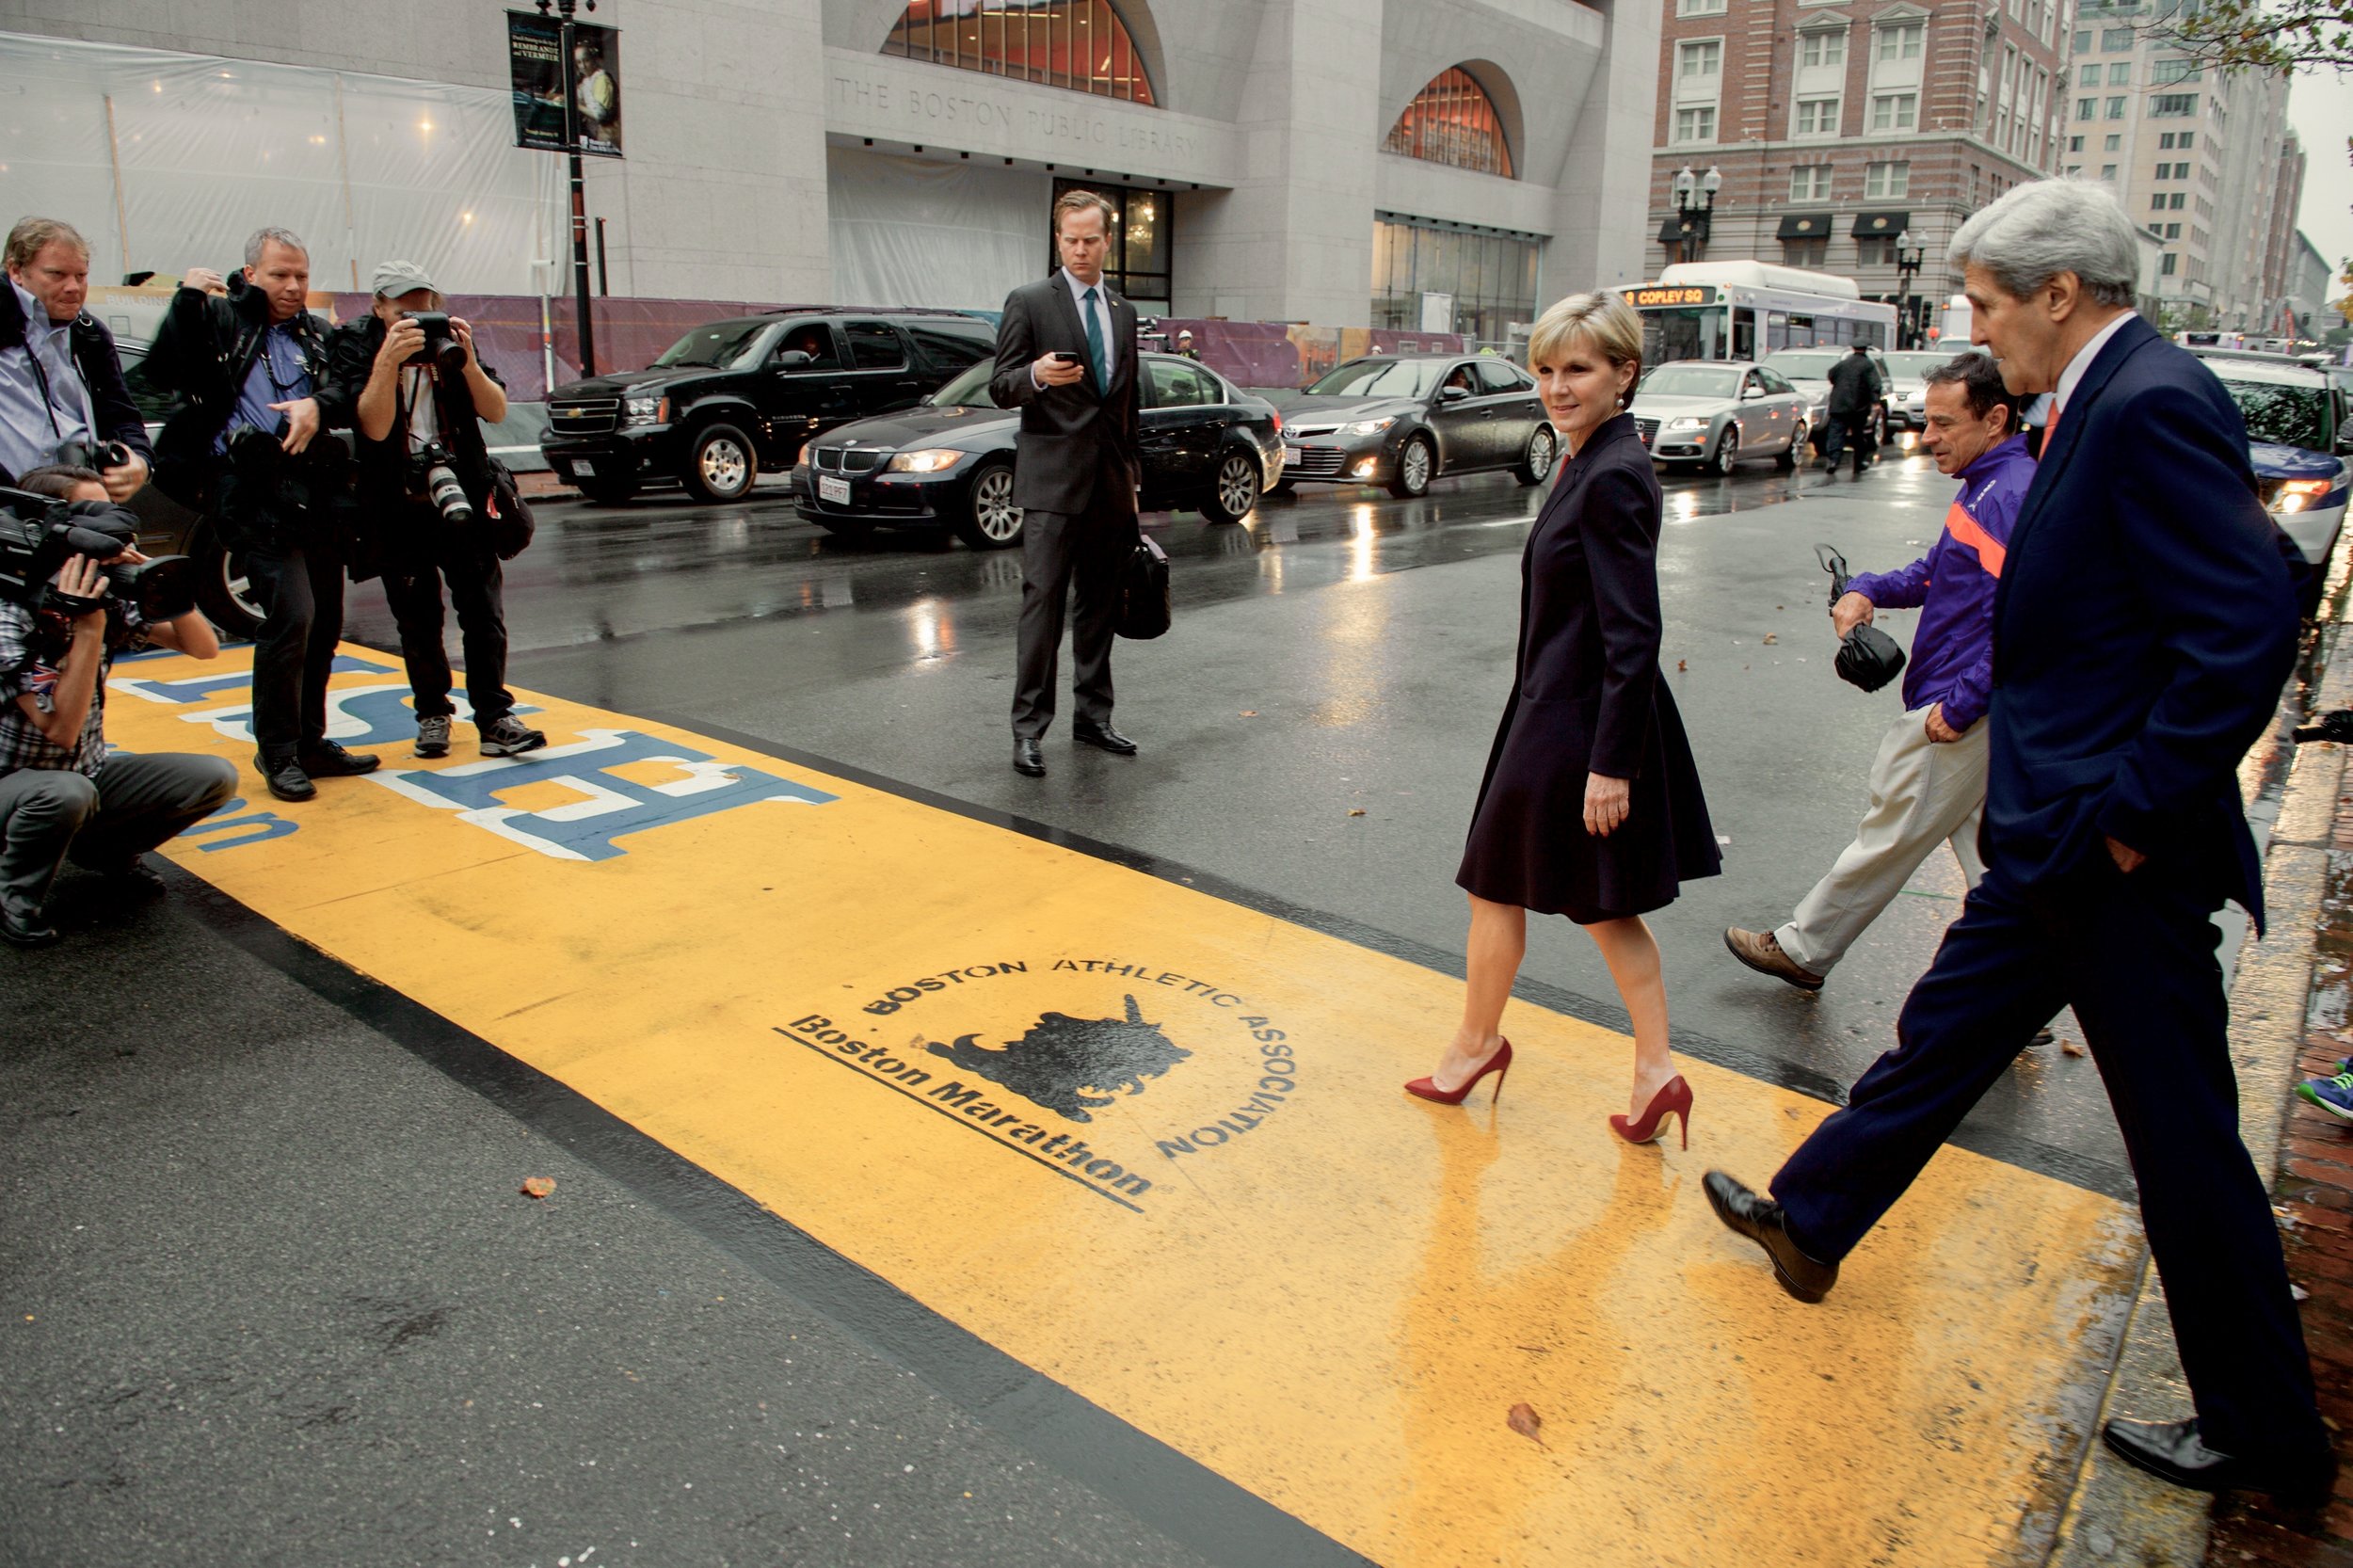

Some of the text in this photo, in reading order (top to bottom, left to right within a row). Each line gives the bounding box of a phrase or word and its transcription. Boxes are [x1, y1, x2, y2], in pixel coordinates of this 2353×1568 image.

[834, 77, 1197, 159] THE BOSTON PUBLIC LIBRARY
[1639, 290, 1684, 305] COPLEY
[1685, 288, 1703, 304] SQ
[789, 1014, 1152, 1195] Boston Marathon
[862, 960, 1295, 1159] BOSTON ATHLETIC ASSOCIATION
